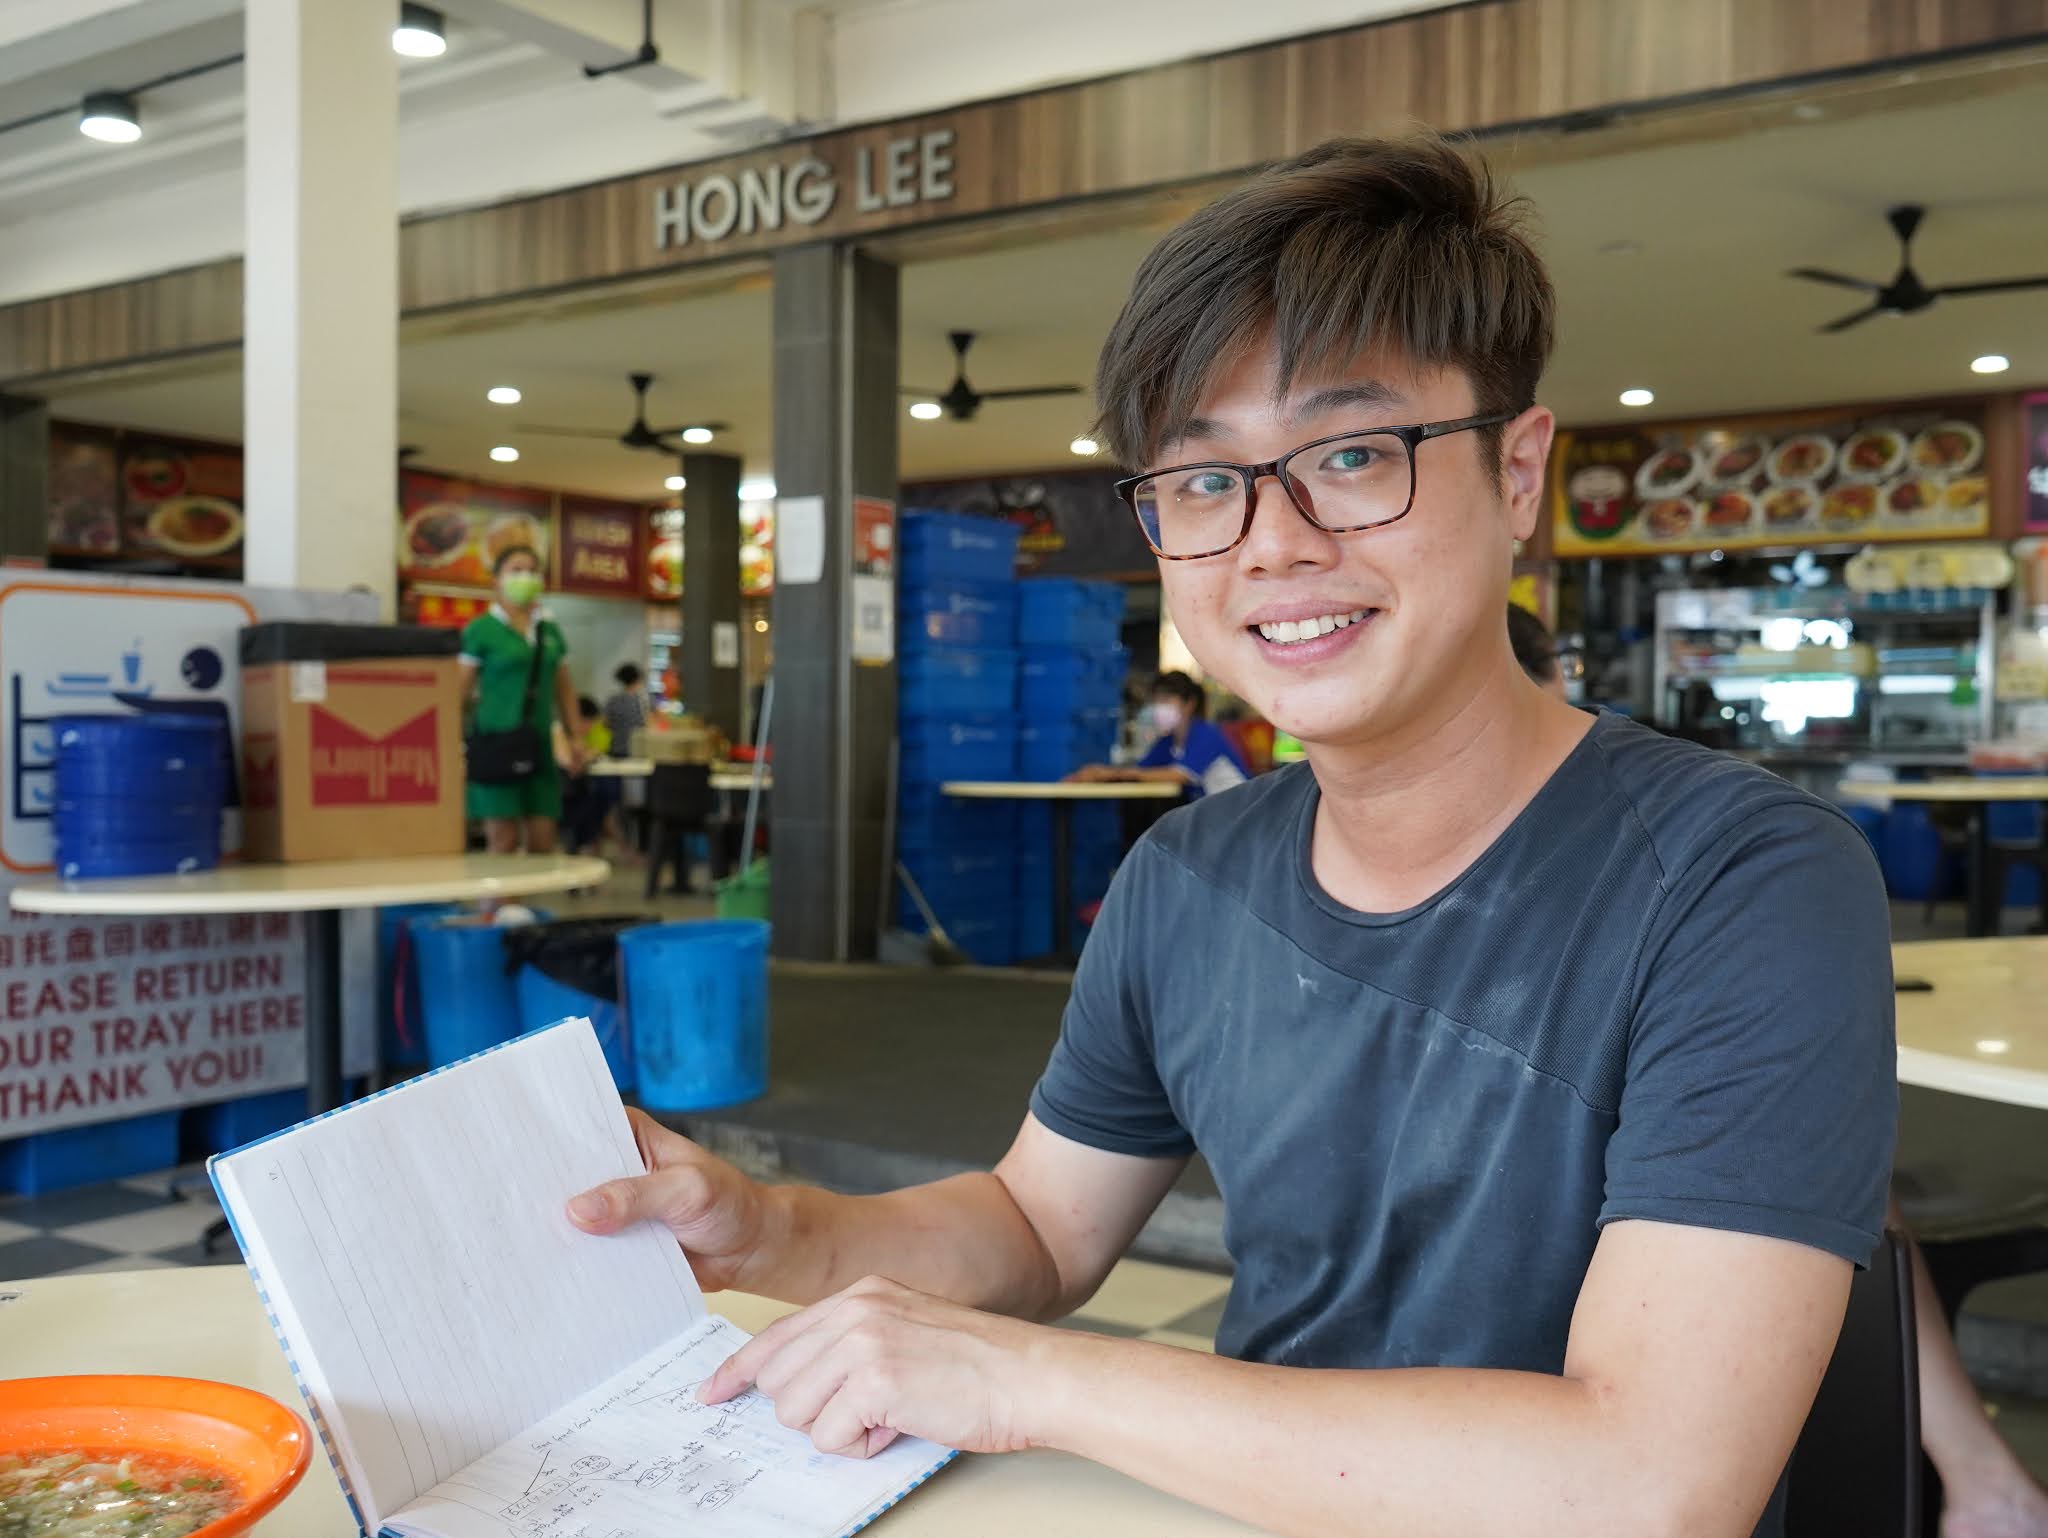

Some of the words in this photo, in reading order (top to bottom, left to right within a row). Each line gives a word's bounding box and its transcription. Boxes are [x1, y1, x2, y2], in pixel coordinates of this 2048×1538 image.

[655, 157, 836, 249] HONG
[856, 130, 954, 211] LEE
[0, 971, 117, 1022] EASE
[134, 954, 282, 1005] RETURN
[91, 1009, 195, 1057] TRAY
[210, 996, 305, 1039] HERE
[0, 1064, 147, 1120] THANK
[165, 1046, 265, 1092] YOU!
